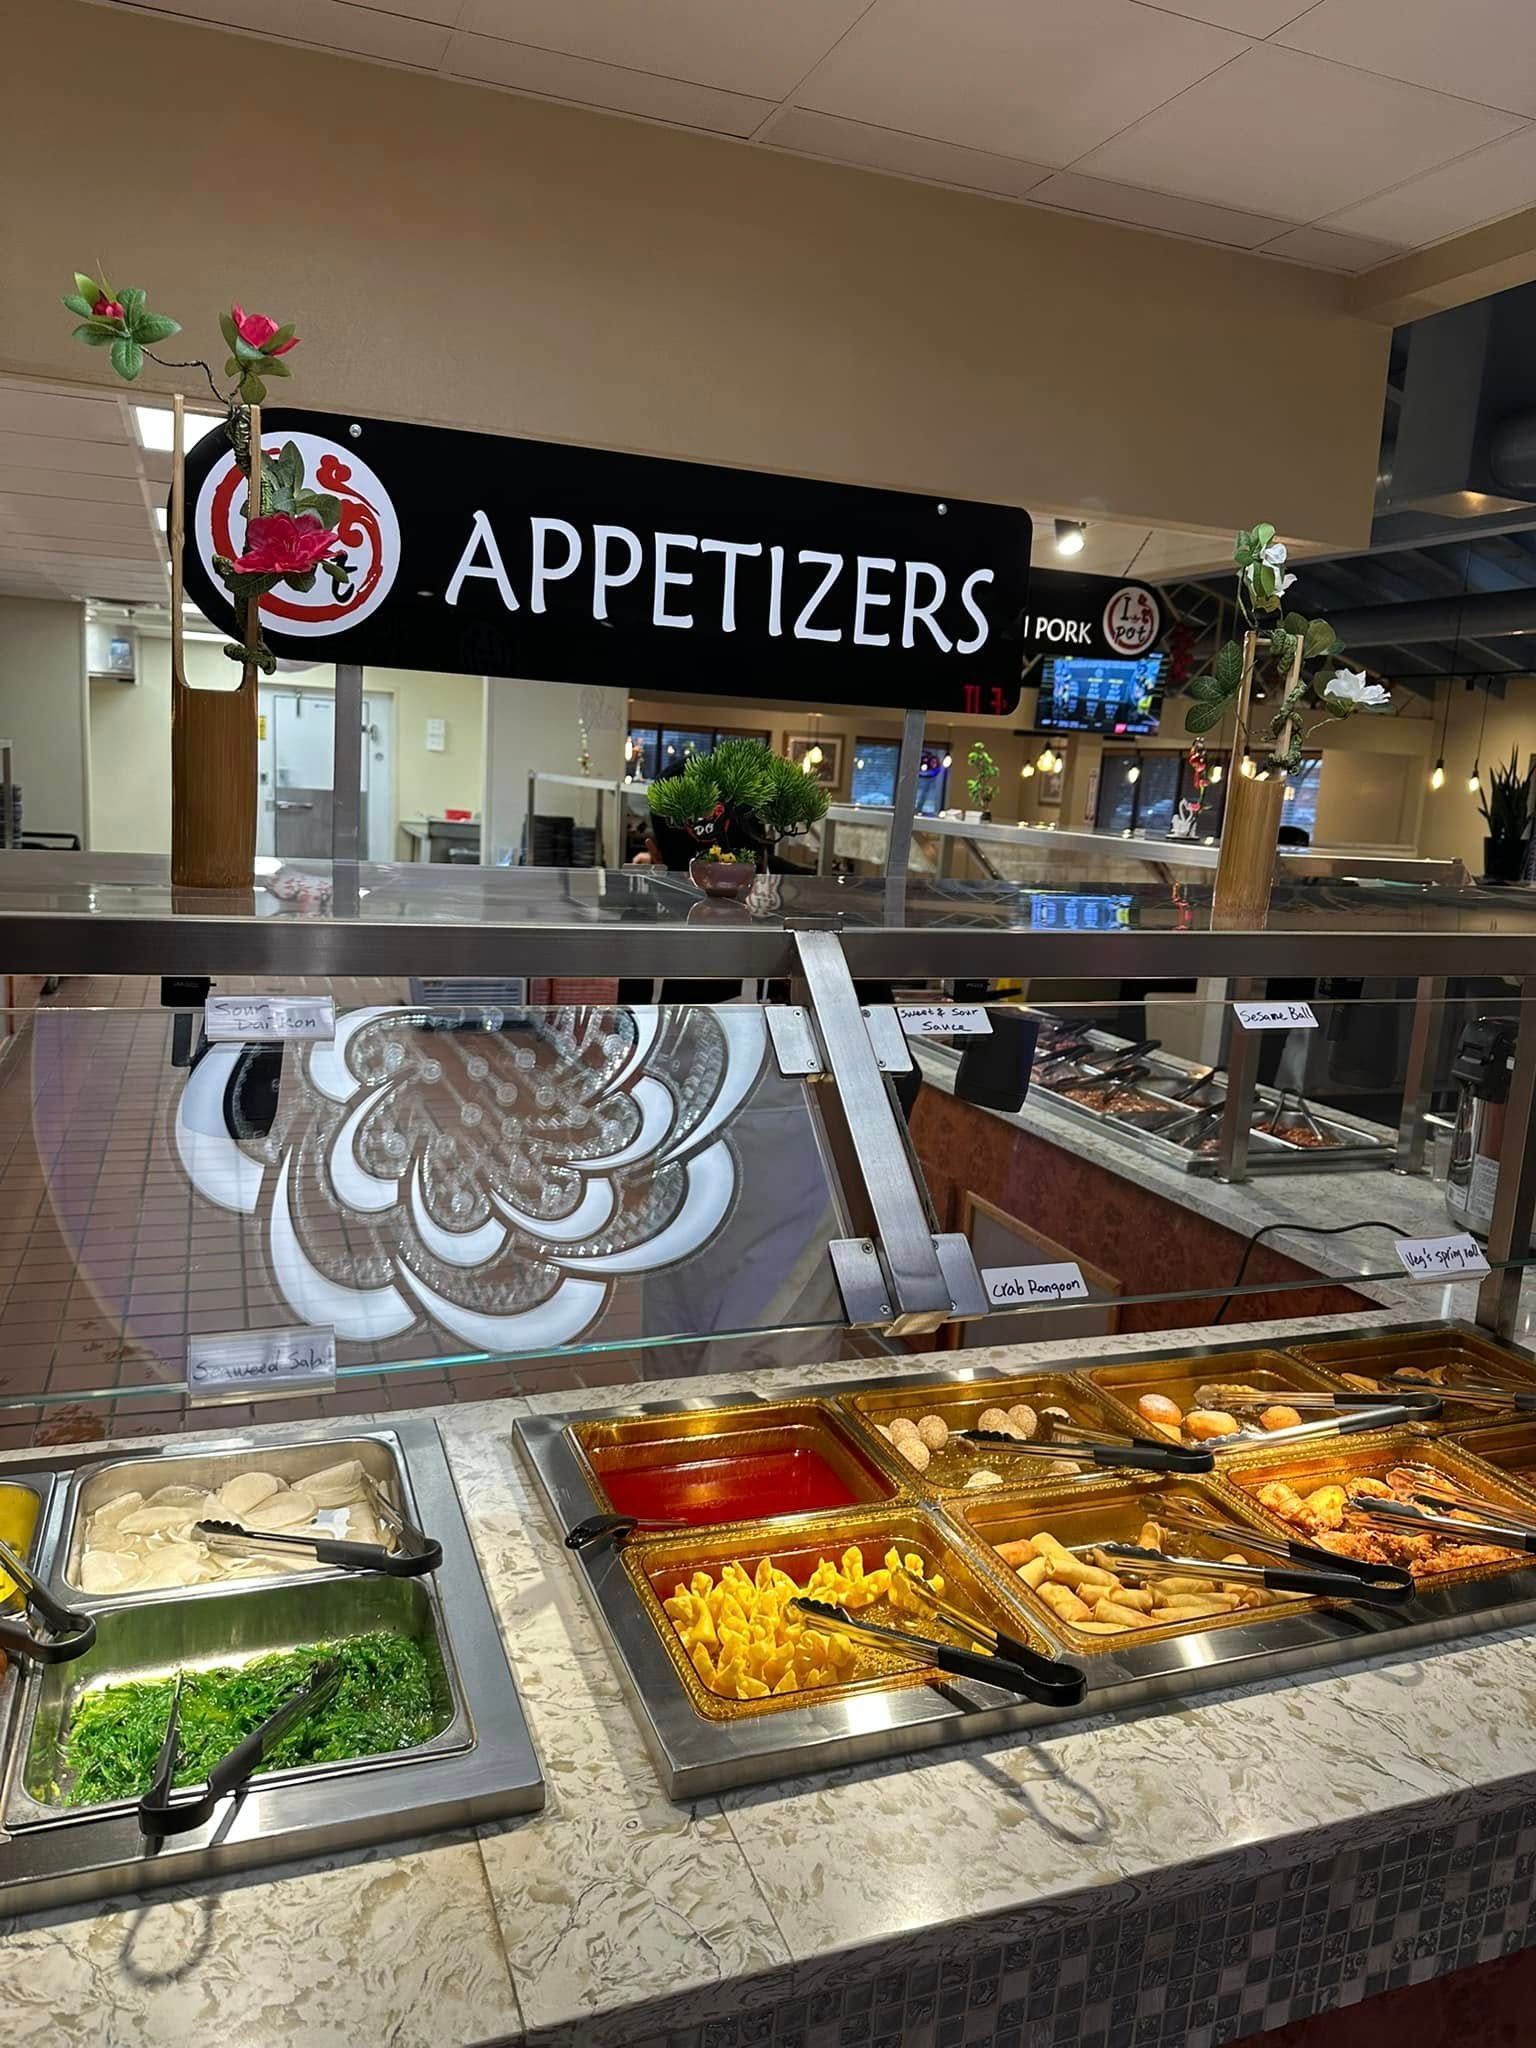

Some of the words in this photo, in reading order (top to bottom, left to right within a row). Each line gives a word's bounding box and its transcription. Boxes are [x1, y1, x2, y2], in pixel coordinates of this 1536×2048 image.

[444, 509, 995, 655] APPETIZERS
[1035, 616, 1092, 645] PORK
[1114, 625, 1147, 645] pot
[214, 1003, 269, 1017] Sour
[900, 1007, 935, 1018] Sweet
[951, 1008, 979, 1016] Sour
[1240, 1010, 1288, 1023] Sesame
[1288, 1006, 1313, 1020] Ball
[921, 1021, 973, 1032] Sauce
